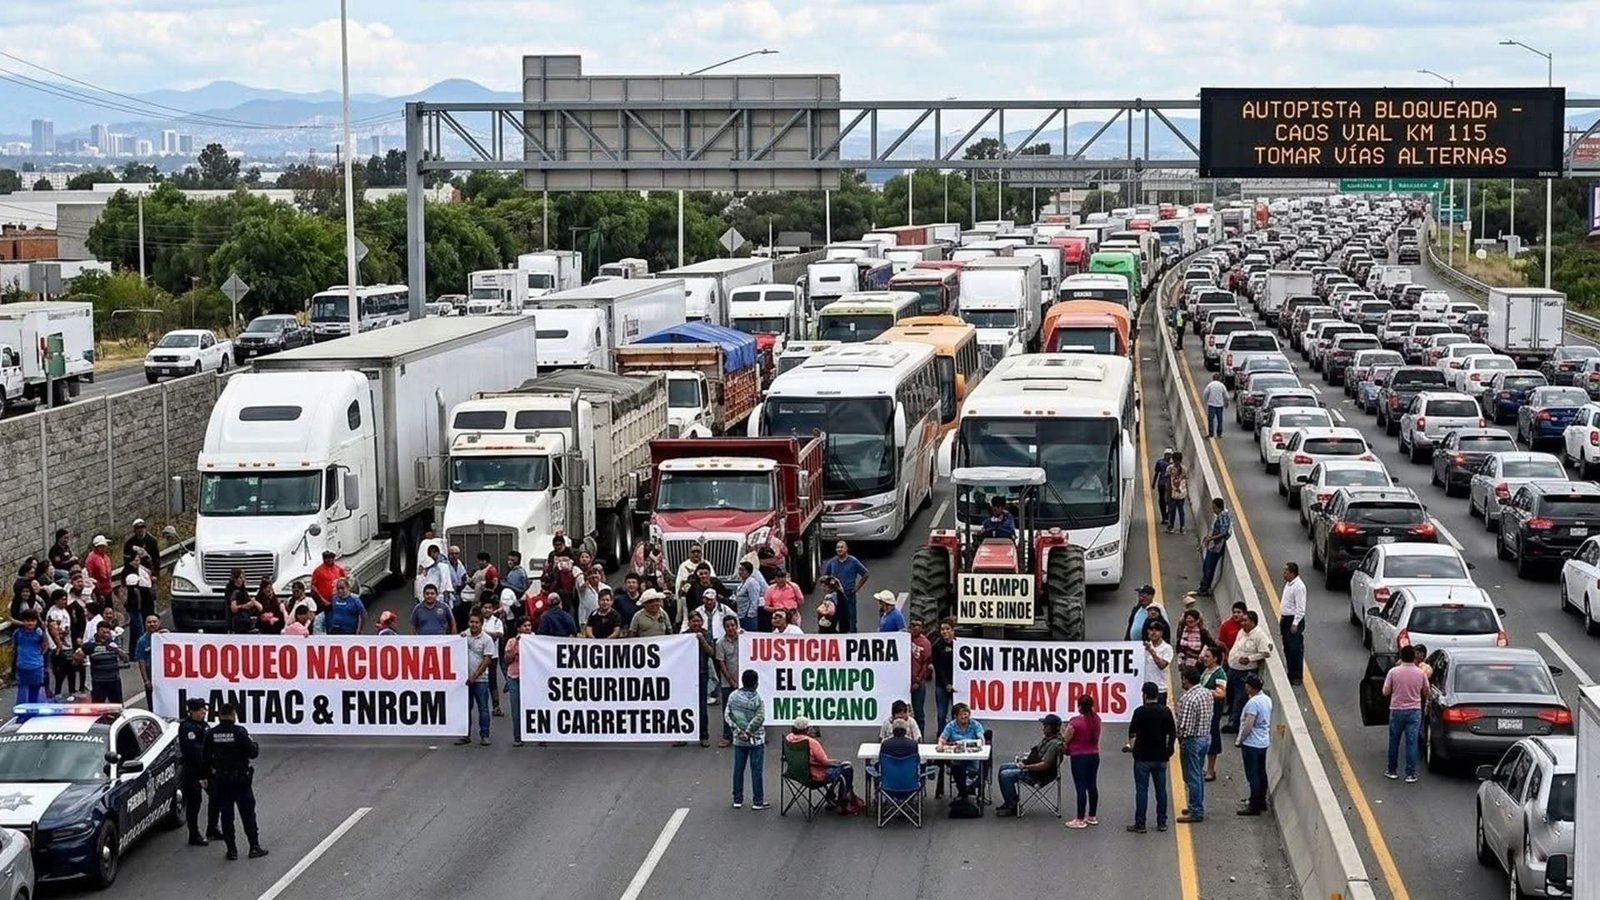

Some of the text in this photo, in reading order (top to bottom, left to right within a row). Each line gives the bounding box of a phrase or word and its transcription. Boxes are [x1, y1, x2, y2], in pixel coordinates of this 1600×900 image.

[1243, 101, 1360, 118] AUTOPISTA
[1376, 101, 1497, 118] BLOQUEADA
[1276, 124, 1486, 141] CAOS VIAL KM 115
[1255, 144, 1506, 164] TOMAR VÍAS ALTERNAS
[964, 578, 1028, 596] EL CAMPO
[961, 601, 976, 618] NO
[980, 601, 993, 618] SE
[557, 644, 660, 669] EXIGIMOS
[751, 639, 898, 661] JUSTICIA PARA
[959, 646, 1138, 676] SIN TRANSPORTE,
[163, 644, 456, 682] BLOQUEO NACIONAL
[548, 677, 670, 701] SEGURIDAD
[776, 668, 874, 691] EL CAMPO
[970, 677, 1126, 714] NO HAY PAÍS
[312, 695, 333, 724] &
[342, 691, 446, 725] FNRCM
[774, 698, 877, 720] MEXICANO
[526, 709, 694, 734] EN CARRETERAS
